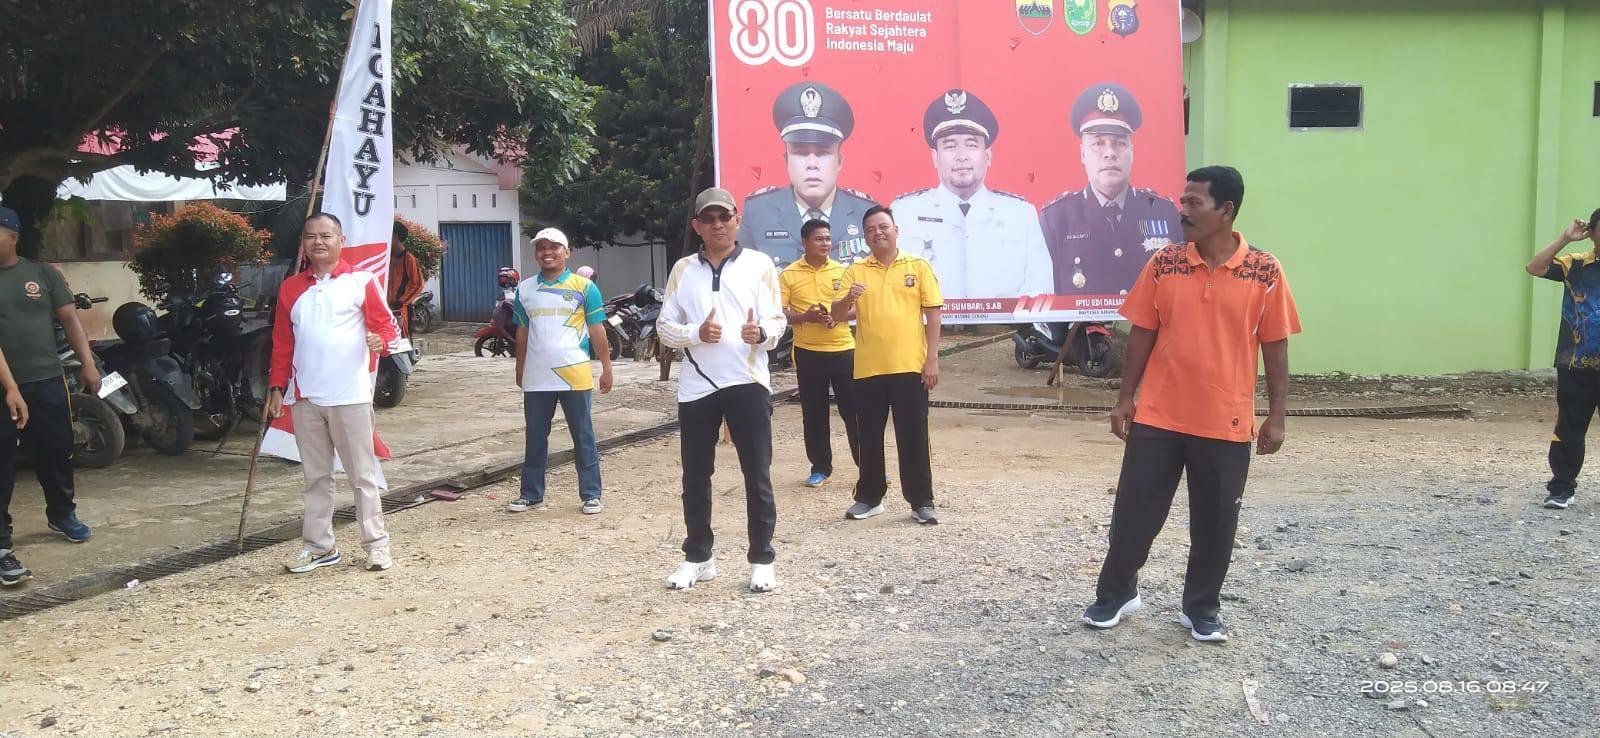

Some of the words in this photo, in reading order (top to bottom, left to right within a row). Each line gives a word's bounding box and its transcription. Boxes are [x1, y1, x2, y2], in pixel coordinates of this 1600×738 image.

[825, 7, 872, 20] Bersatu
[875, 9, 932, 23] Berdaulat
[728, 0, 815, 67] 80
[825, 23, 867, 37] Rakyat
[870, 25, 927, 38] Sejahtera
[826, 38, 884, 52] Indonesia
[887, 40, 914, 54] Maju
